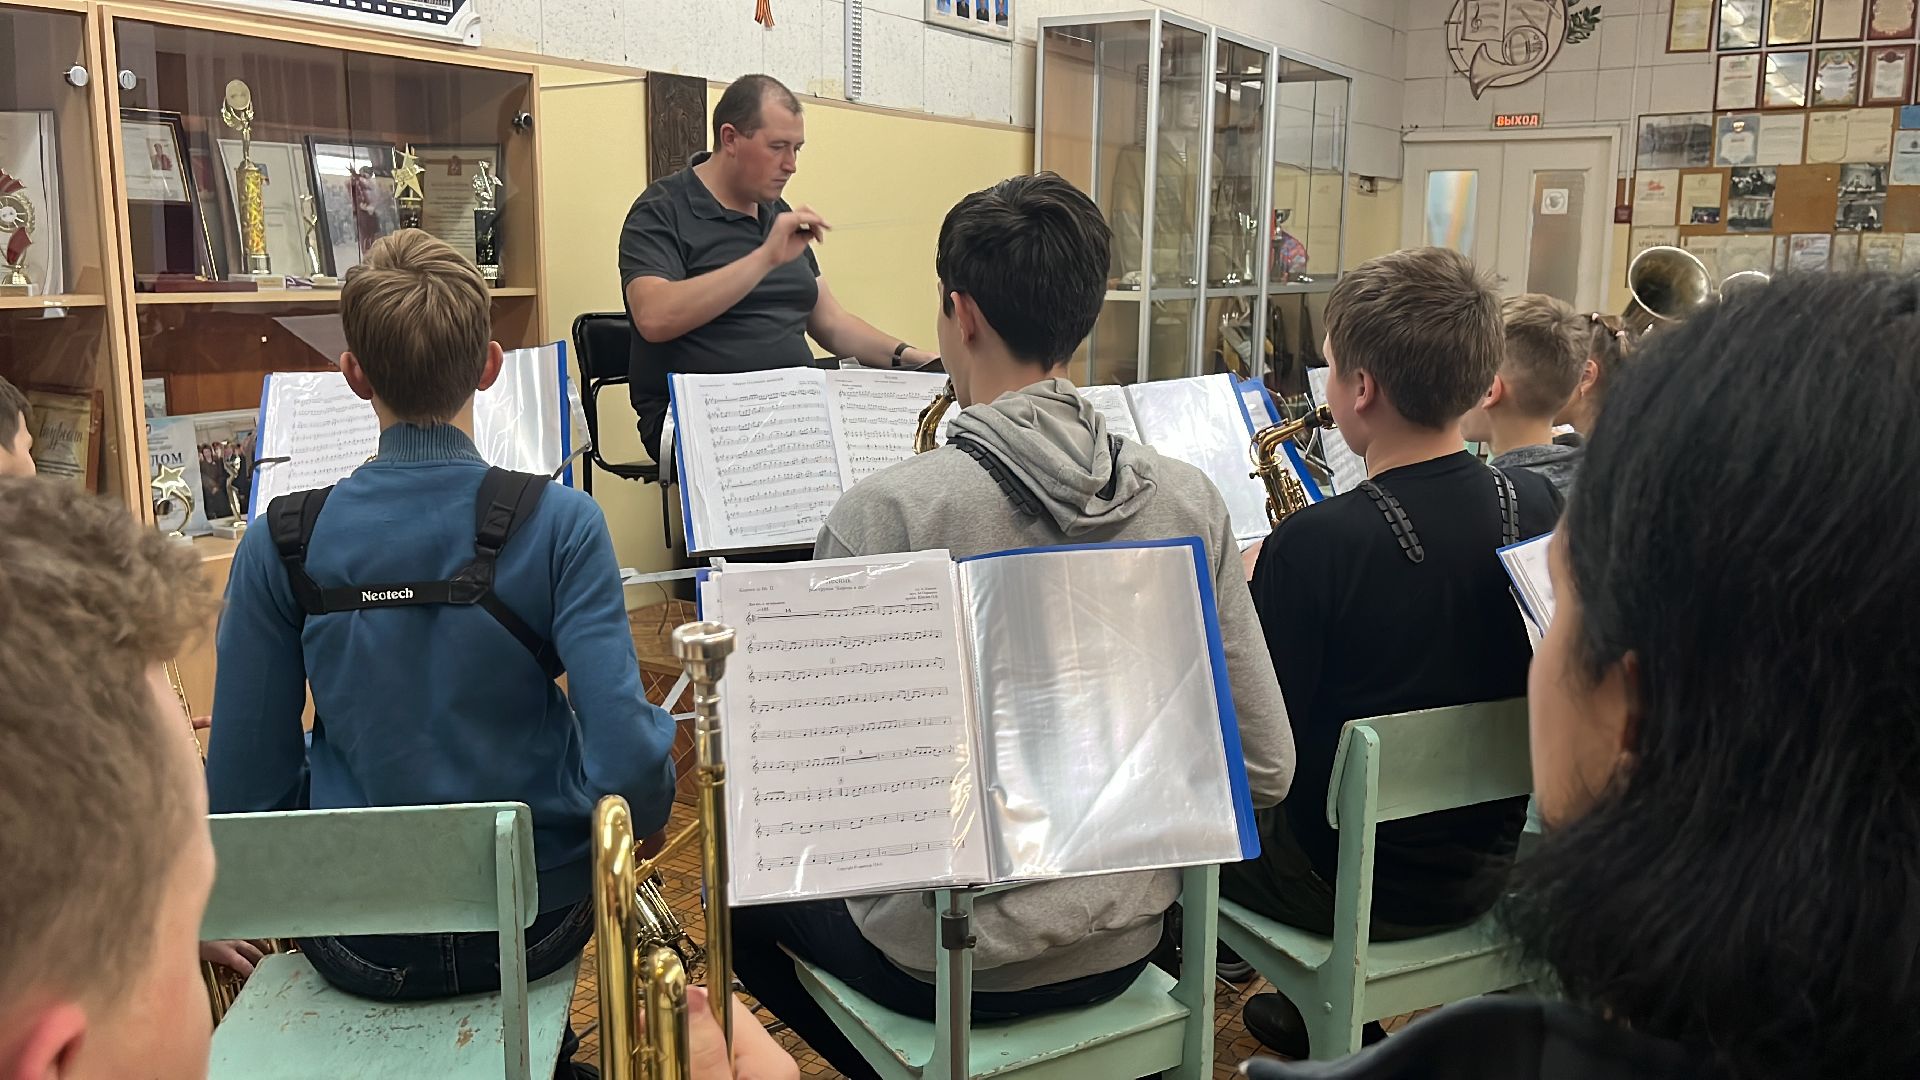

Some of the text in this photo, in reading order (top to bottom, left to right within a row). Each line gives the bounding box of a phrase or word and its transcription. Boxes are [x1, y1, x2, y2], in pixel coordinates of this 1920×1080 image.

[1496, 114, 1538, 127] ВЫХОД
[151, 452, 183, 466] ЛОМ
[361, 587, 414, 602] Neotech
